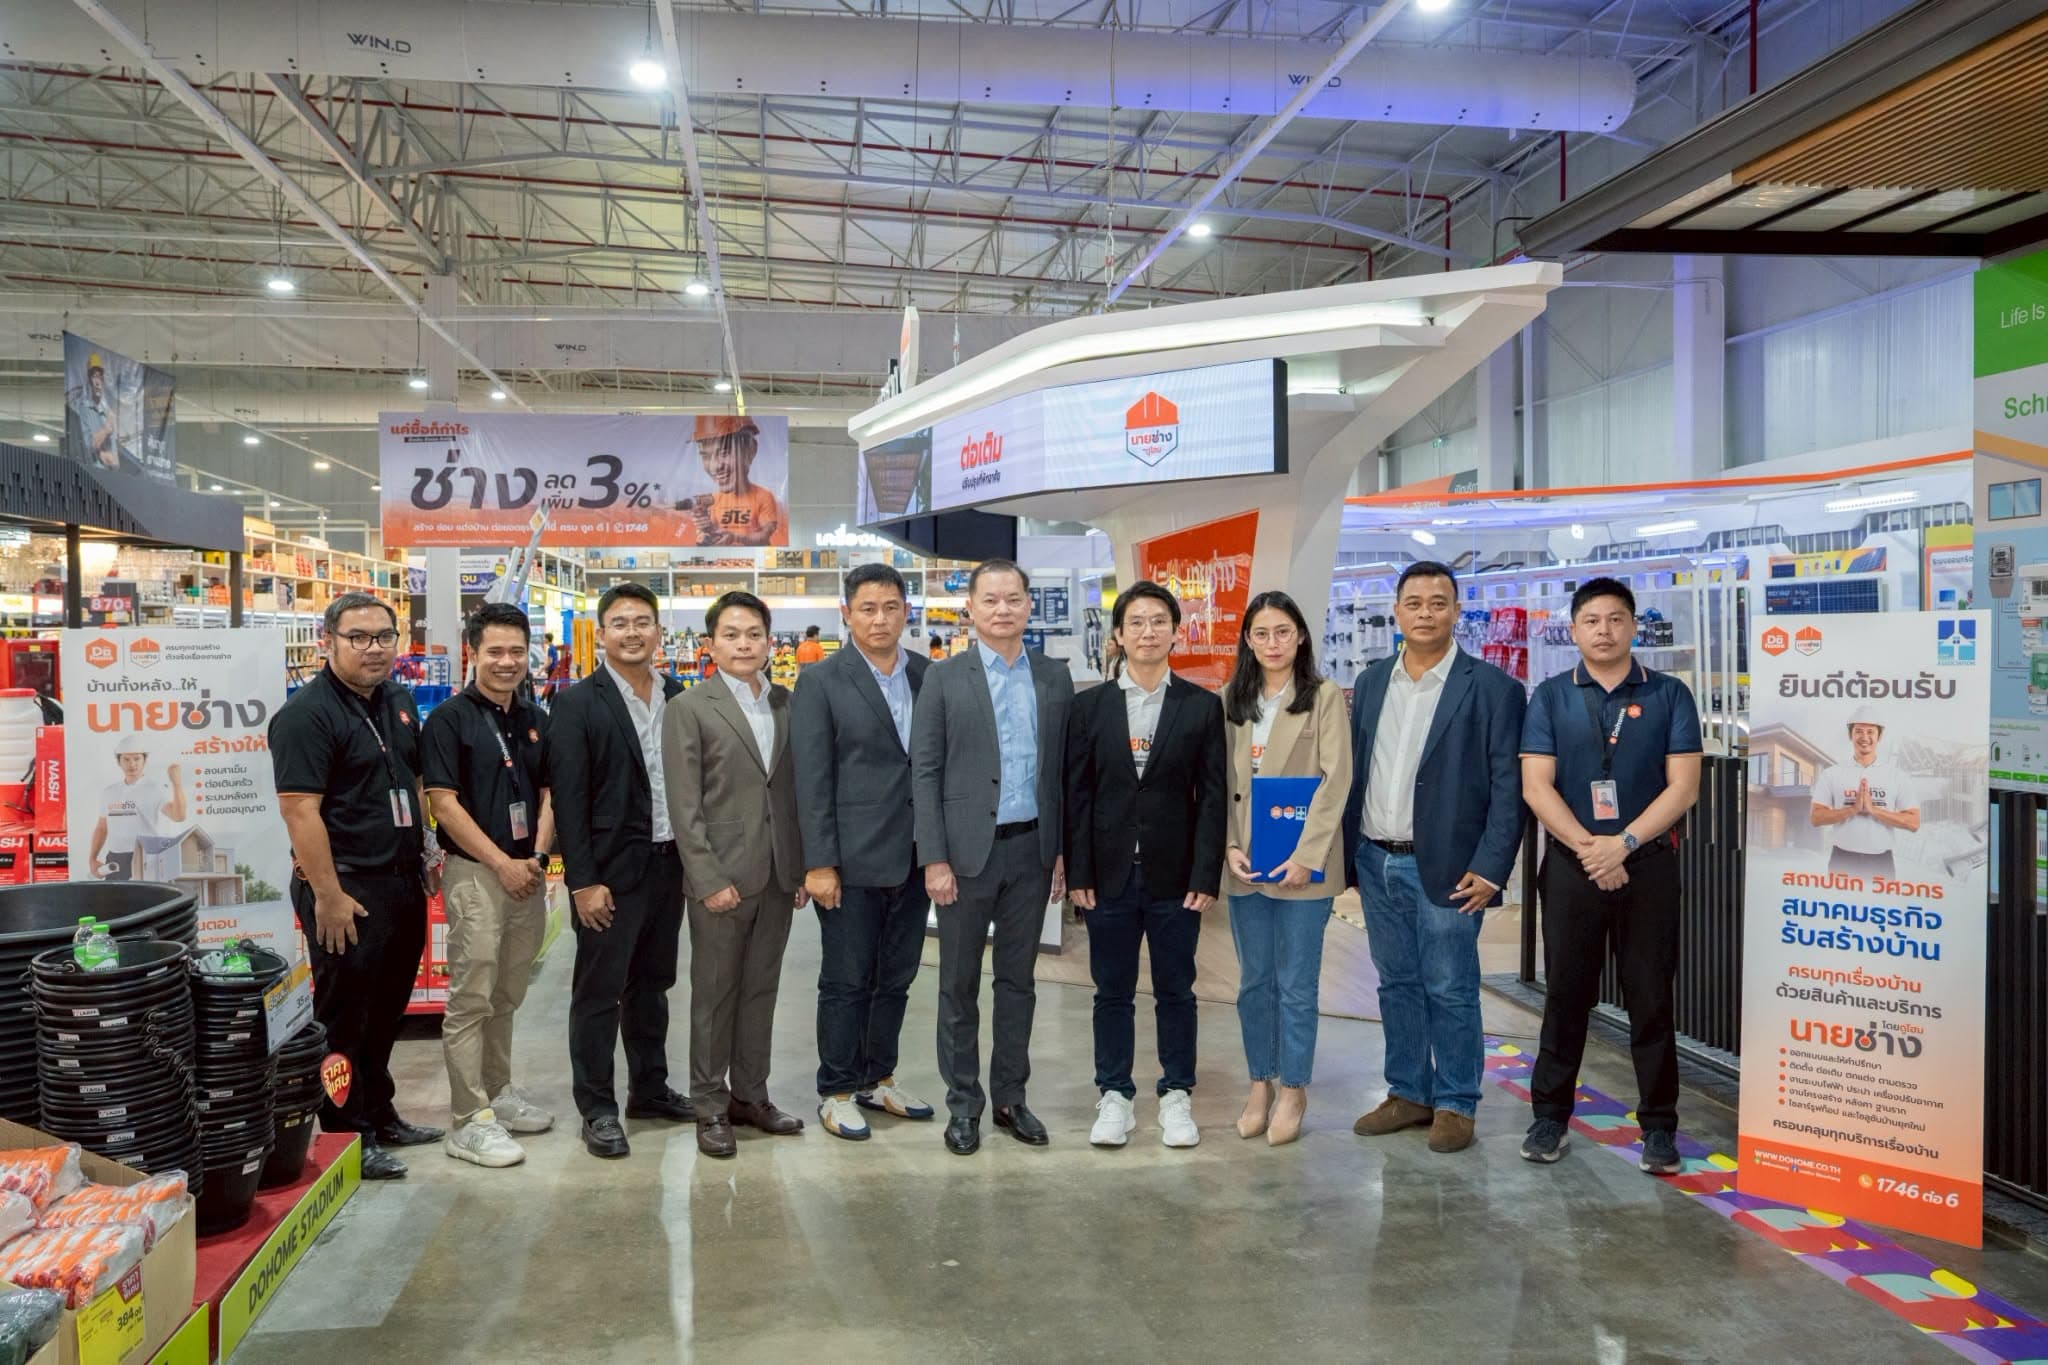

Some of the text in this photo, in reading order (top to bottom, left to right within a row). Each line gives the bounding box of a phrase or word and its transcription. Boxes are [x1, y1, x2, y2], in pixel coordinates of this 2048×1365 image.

[347, 32, 411, 55] WIN.D
[2000, 303, 2045, 328] Life Is
[554, 343, 587, 352] WIN.D
[2004, 392, 2048, 419] Sch
[390, 418, 469, 436] แค่ซื้อก็กำไร
[1131, 429, 1173, 446] นายช่าง
[410, 448, 538, 510] ช่าง
[544, 473, 576, 489] ลด
[541, 490, 574, 510] เพิ่ม
[625, 523, 648, 532] 1746
[720, 509, 752, 525] ฮีโร่
[91, 598, 124, 611] 870
[1778, 670, 1957, 701] ยินดีต้อนรับ
[87, 688, 267, 734] นายช่าง
[48, 759, 60, 802] NASH
[205, 791, 258, 802] ระบบหลังคา
[37, 836, 69, 848] NAS
[1781, 871, 1944, 900] สถาปนิก วิศวกร
[1781, 897, 1943, 932] สมาคมธุรกิจ
[1781, 920, 1941, 961] รับสร้างบ้าน
[1788, 964, 1922, 993] ครบทุกเรื่องบ้าน
[1775, 981, 1943, 1019] ด้วยสินค้าและบริการ
[1790, 1018, 1923, 1058] นายช่าง
[1789, 1049, 1883, 1071] ออกแบบและให้คำปรึกษา
[1789, 1061, 1918, 1090] ติดตั้ง ต่อเติม ตกแต่ง ตามตรวจ
[1789, 1076, 1944, 1110] งานระบบไฟฟ้า ประปา เครื่องปรับอากาศ
[1789, 1087, 1907, 1115] งานโครงสร้าง หลังคา ฐานราก
[1773, 1118, 1940, 1160] ครอบคลุมทุกบริการเรื่องบ้าน
[1754, 1149, 1841, 1175] WWW.DOHOME.CO.TH
[1877, 1176, 1960, 1209] 1746 ต่อ 6
[248, 1166, 344, 1316] DOHOME STADIUM
[117, 1306, 134, 1332] 384
